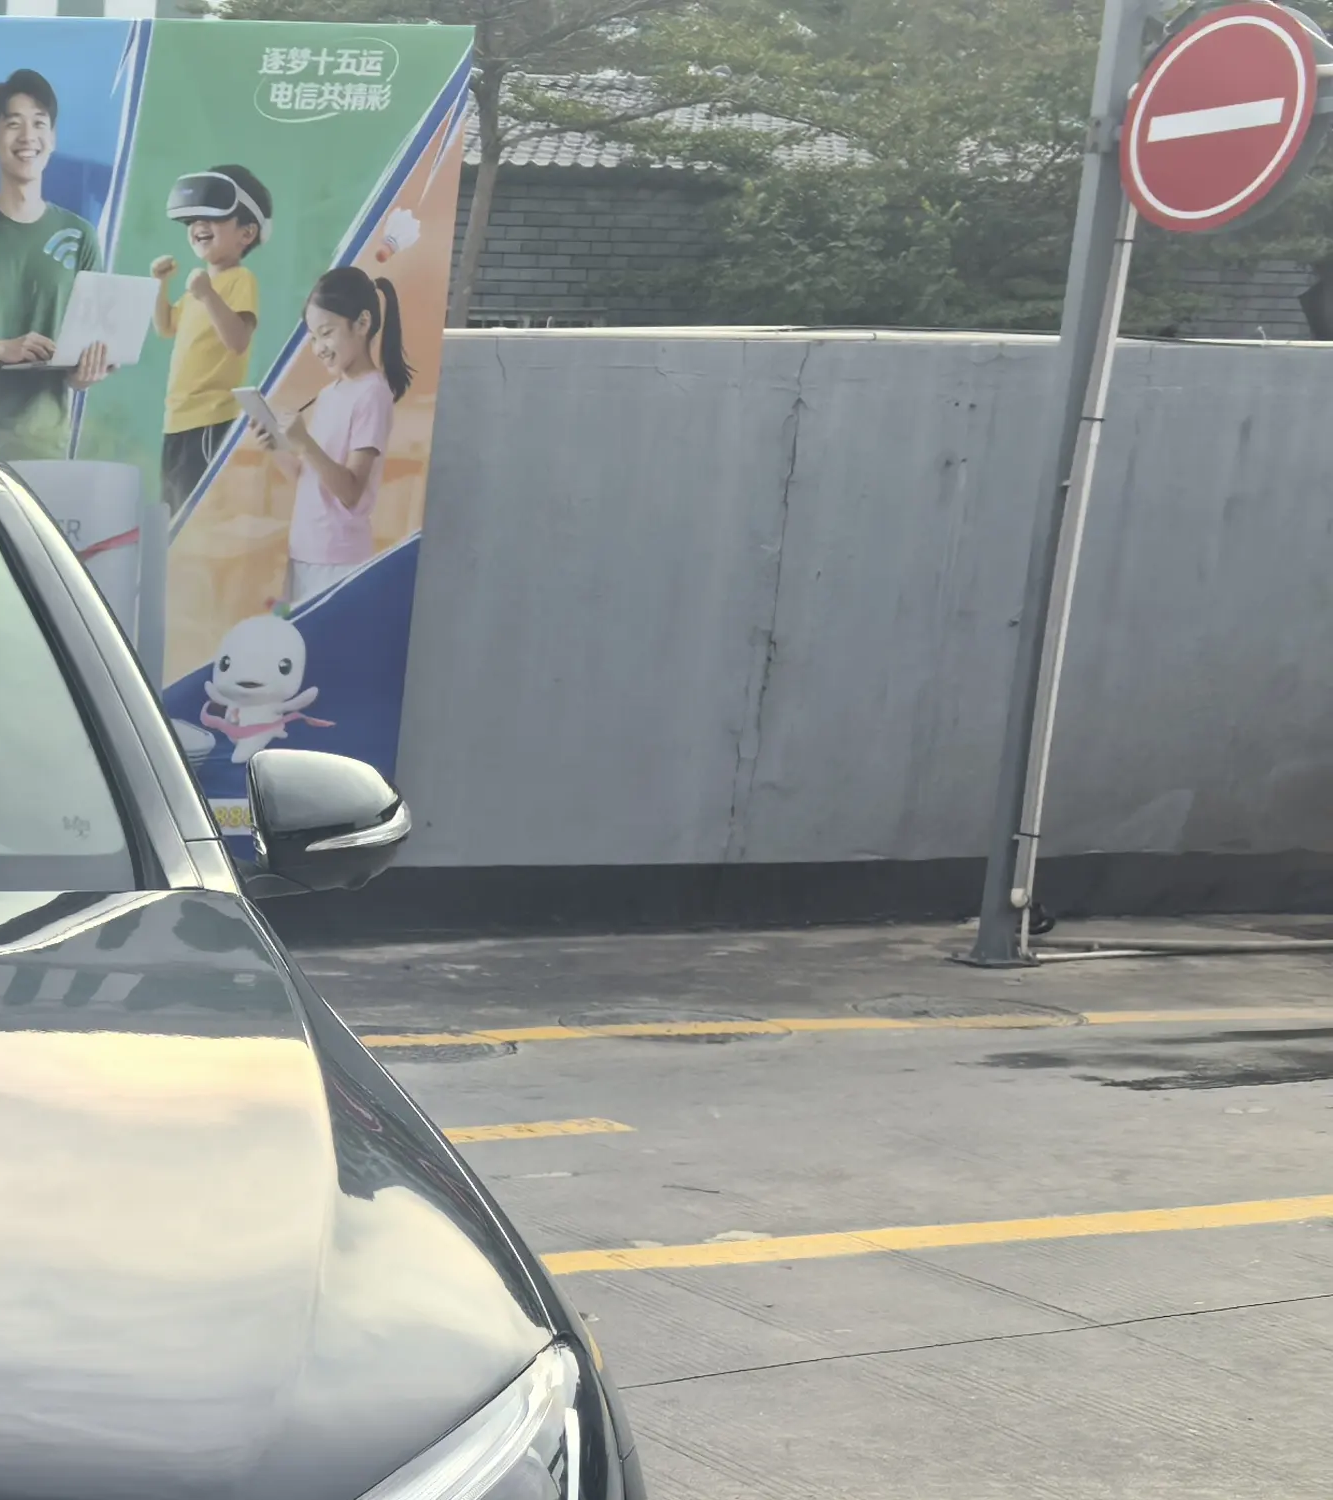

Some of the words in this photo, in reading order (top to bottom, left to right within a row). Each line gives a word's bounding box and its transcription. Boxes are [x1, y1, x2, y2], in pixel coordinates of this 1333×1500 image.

[257, 47, 385, 76] 逐梦十五运
[269, 81, 392, 111] 电信共精彩
